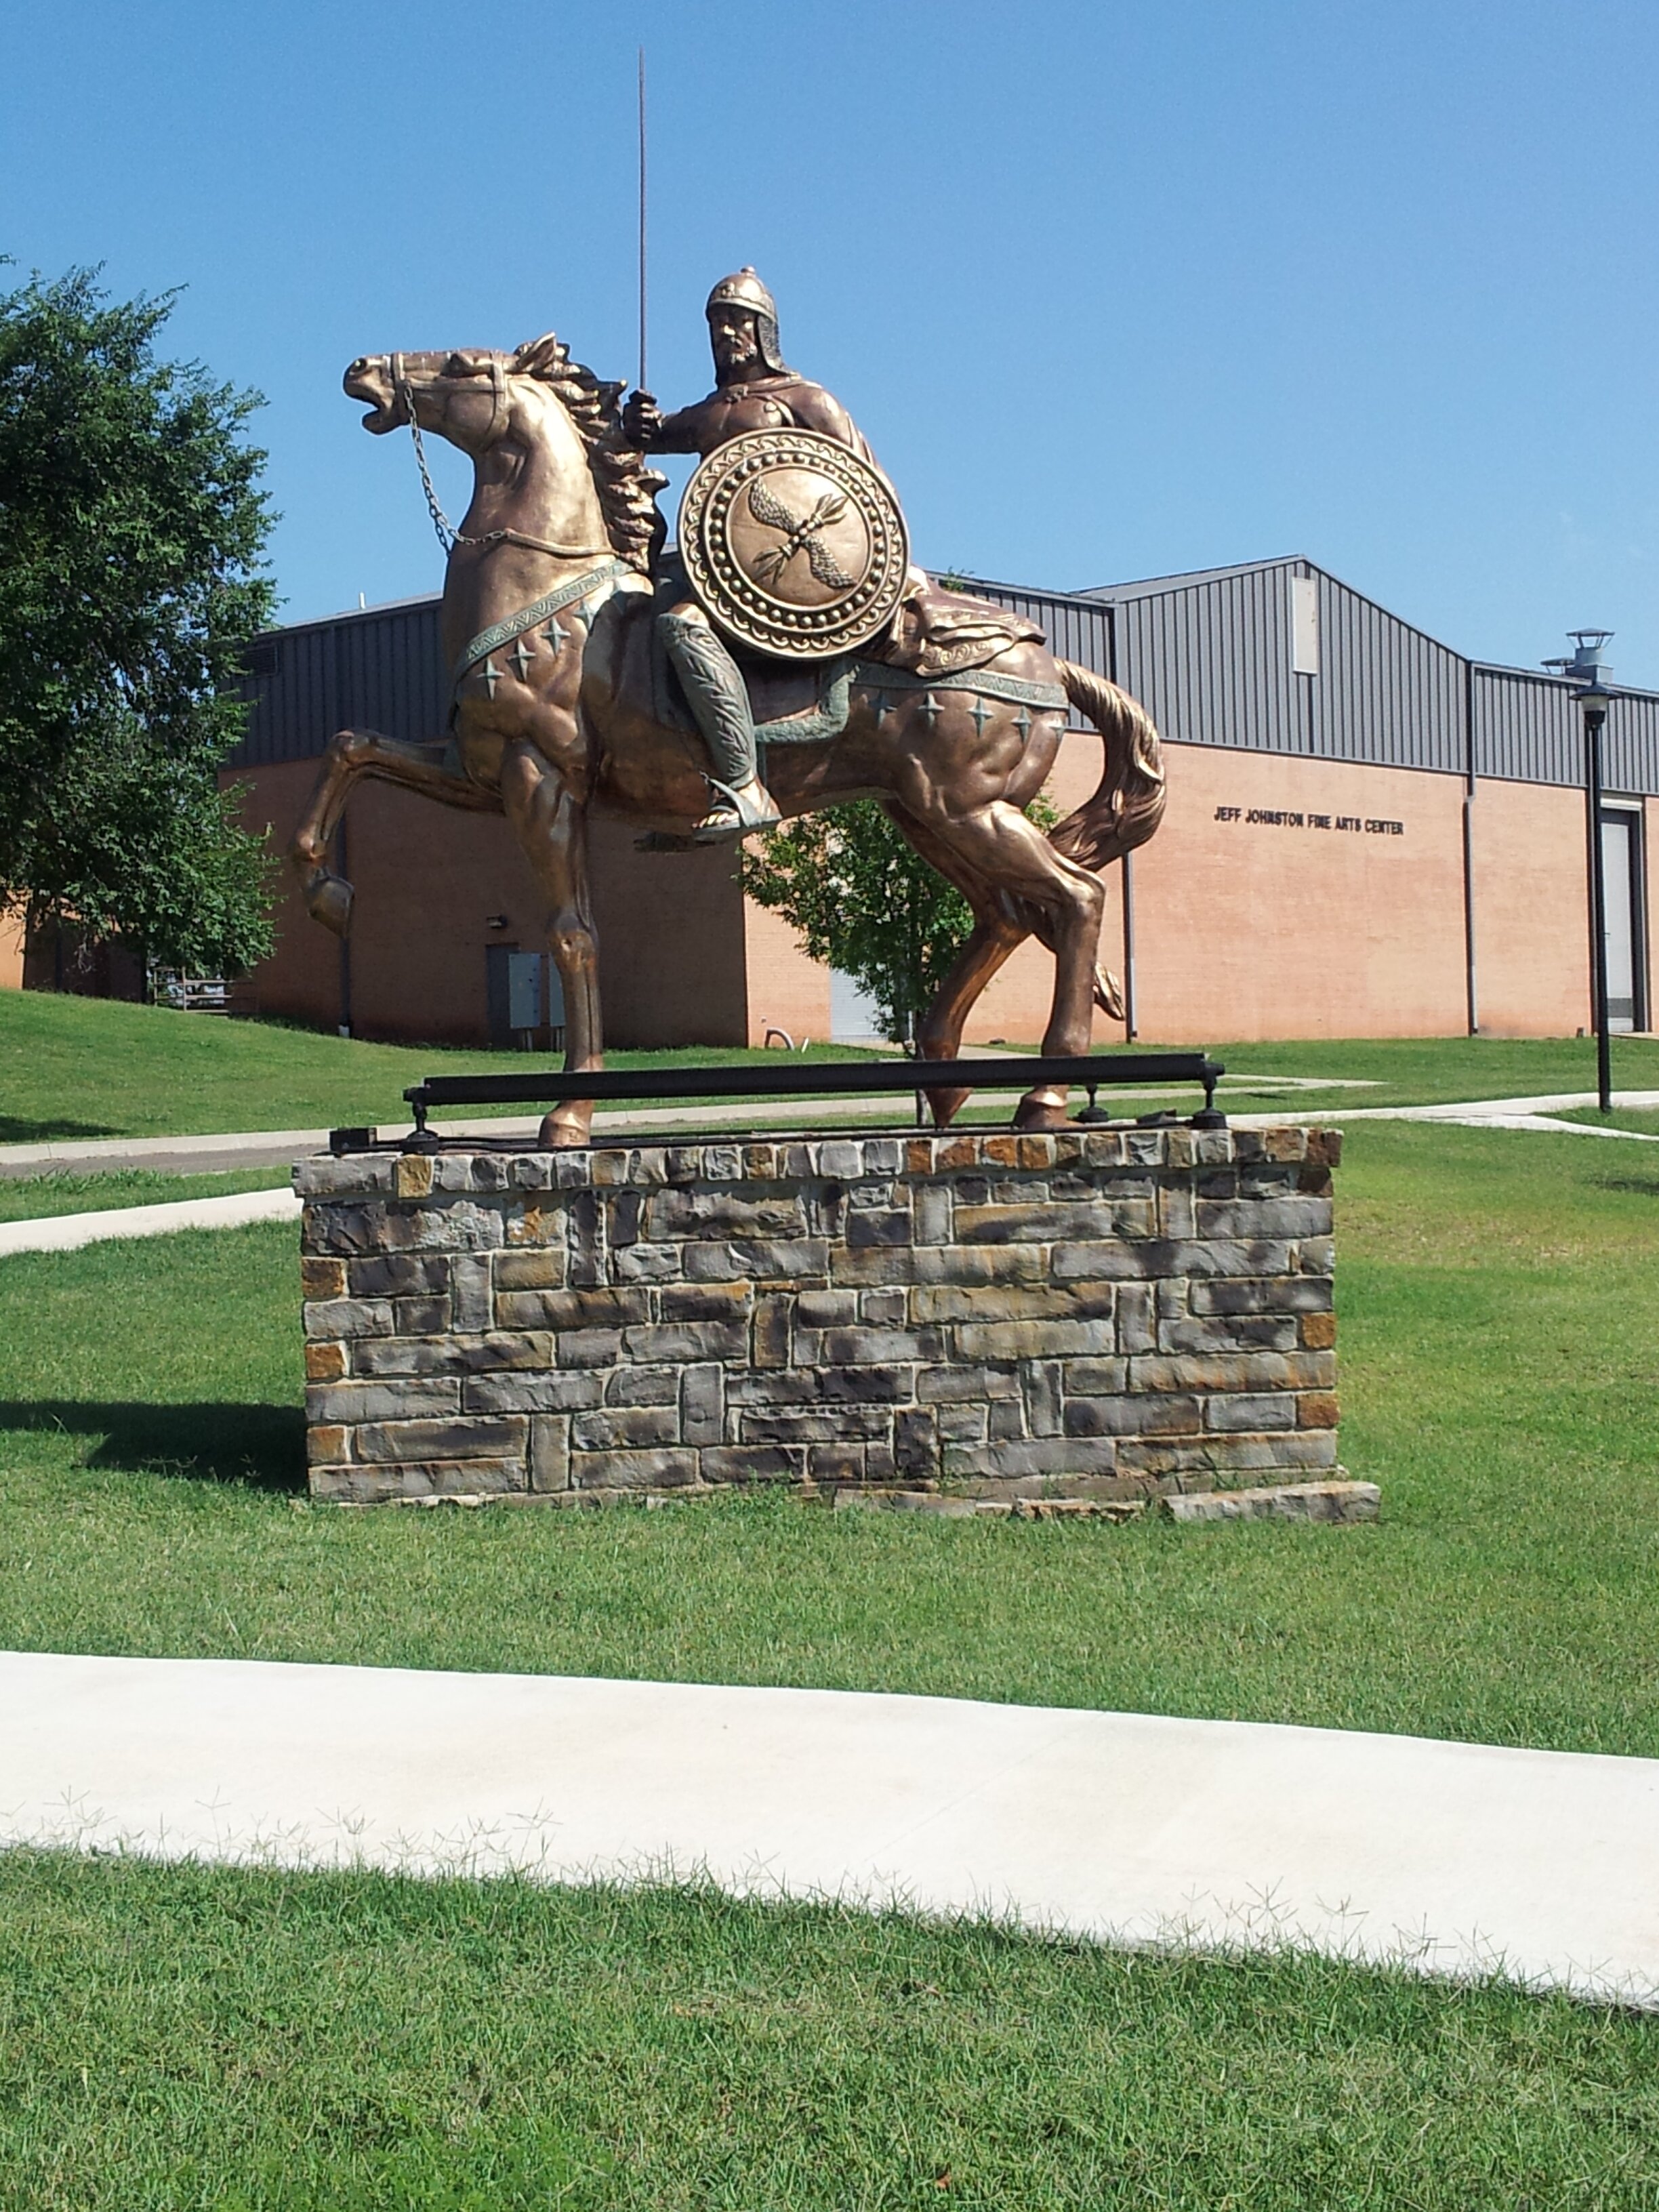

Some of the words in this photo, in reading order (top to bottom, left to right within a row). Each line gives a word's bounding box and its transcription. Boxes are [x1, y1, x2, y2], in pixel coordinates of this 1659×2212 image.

[1214, 806, 1242, 822] JEFF
[1245, 809, 1303, 827] JOHNSTON
[1307, 814, 1331, 830] FINE
[1334, 817, 1361, 832] ARTS
[1365, 819, 1404, 836] CENTER
